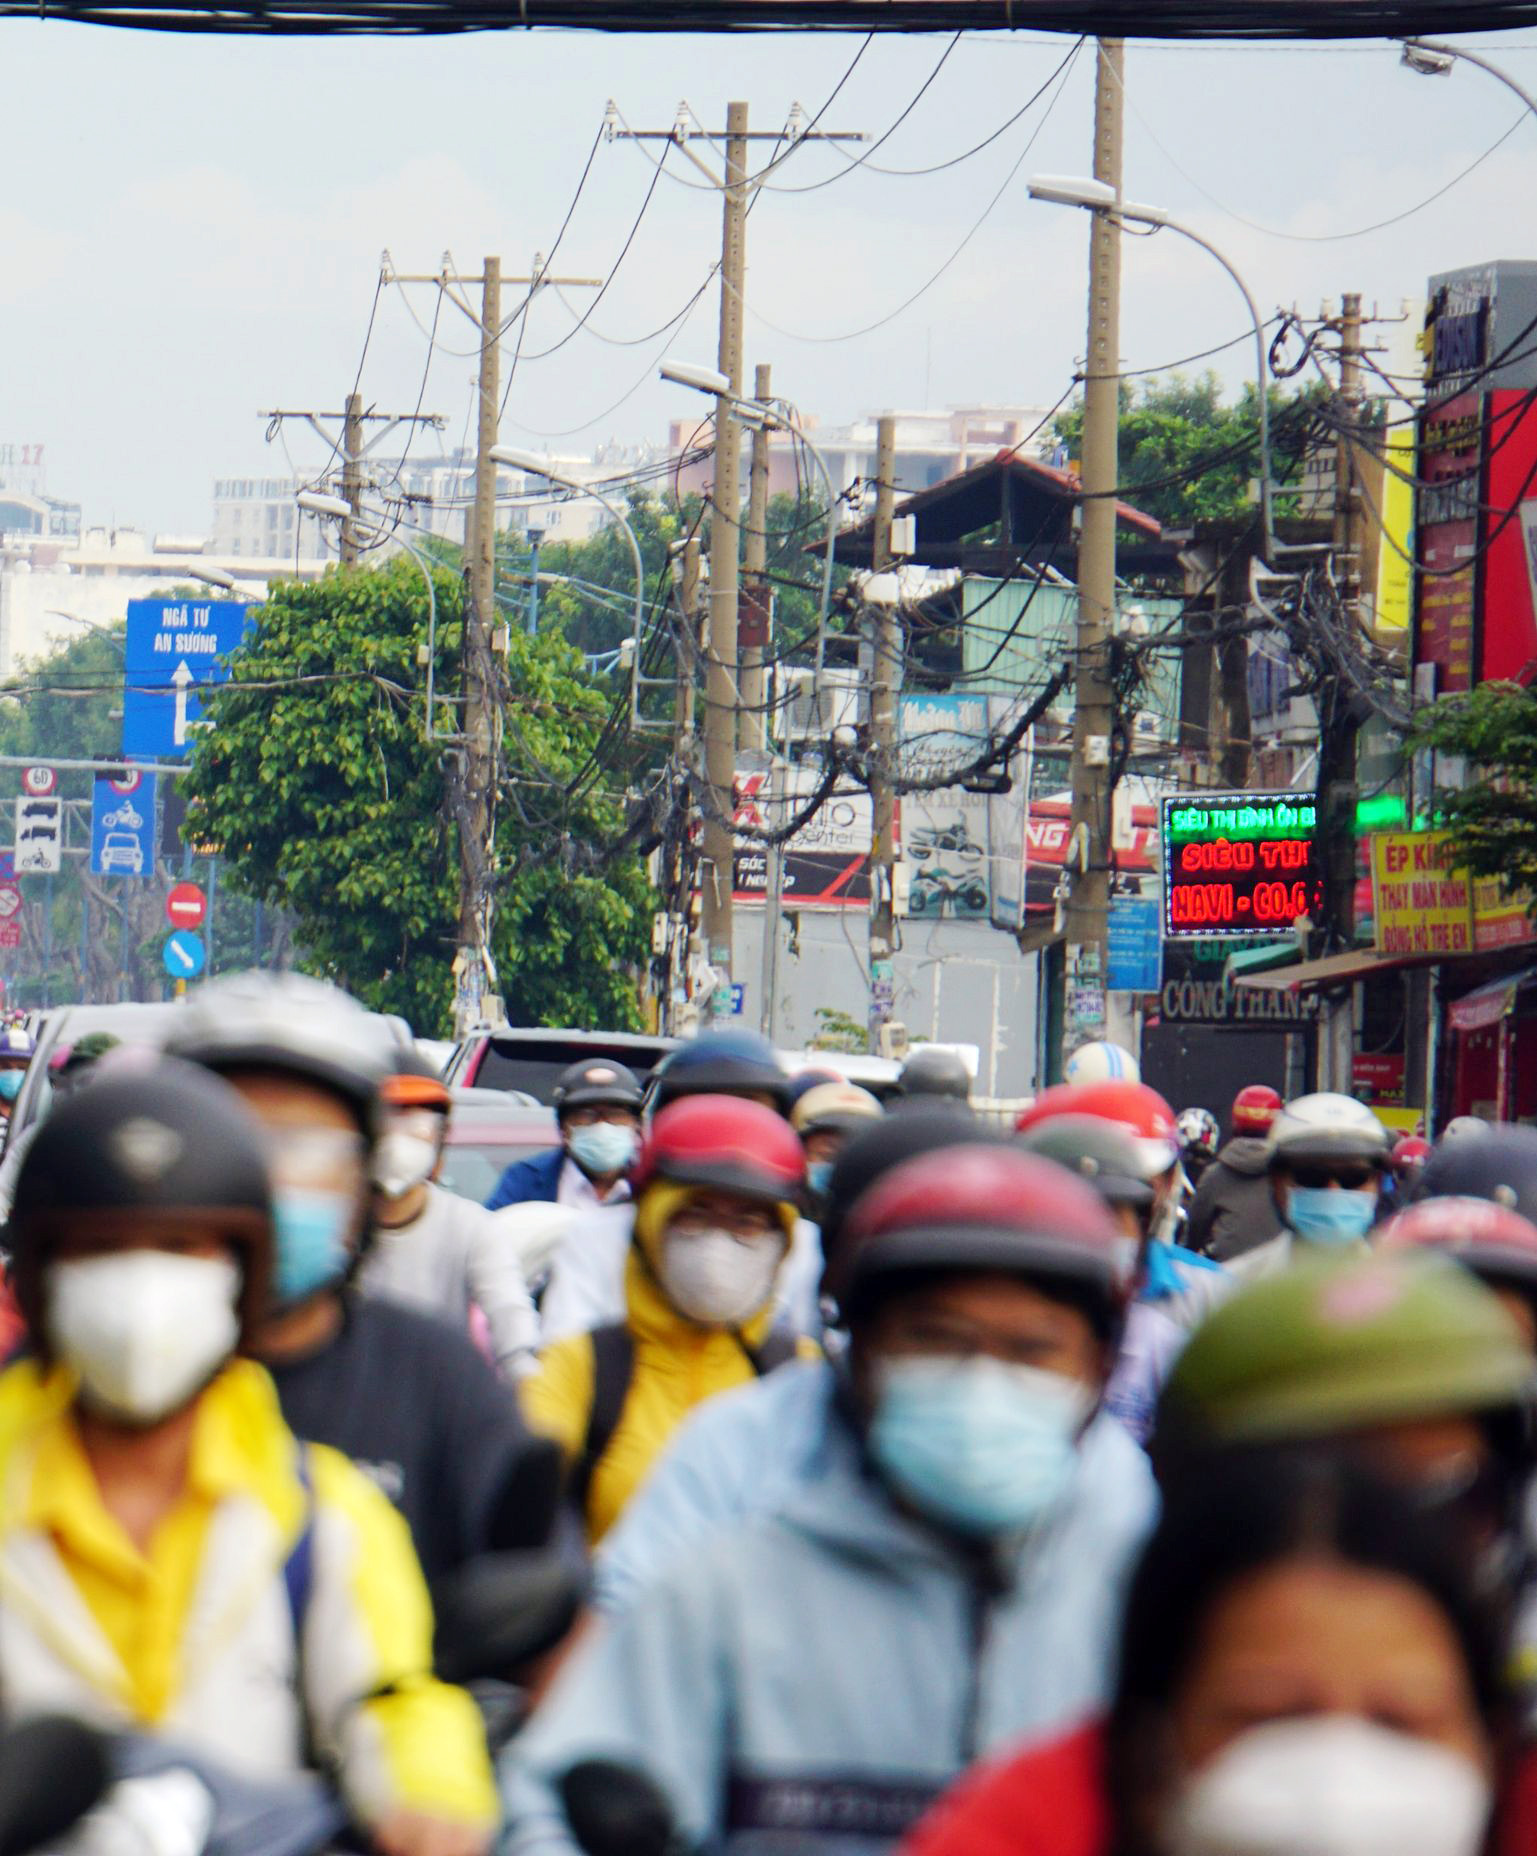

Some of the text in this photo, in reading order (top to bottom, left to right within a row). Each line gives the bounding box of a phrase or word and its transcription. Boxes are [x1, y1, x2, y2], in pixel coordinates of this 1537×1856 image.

[21, 443, 45, 465] 17
[162, 604, 211, 628] NGÃ TƯ
[154, 631, 217, 654] AN SƯƠNG
[33, 770, 49, 785] 60
[1171, 807, 1208, 832] SIÊU
[1182, 837, 1254, 871] SIÊU
[1385, 836, 1409, 873] ÉP
[1172, 884, 1233, 922] NAVI
[1164, 969, 1227, 1018] CÔNG
